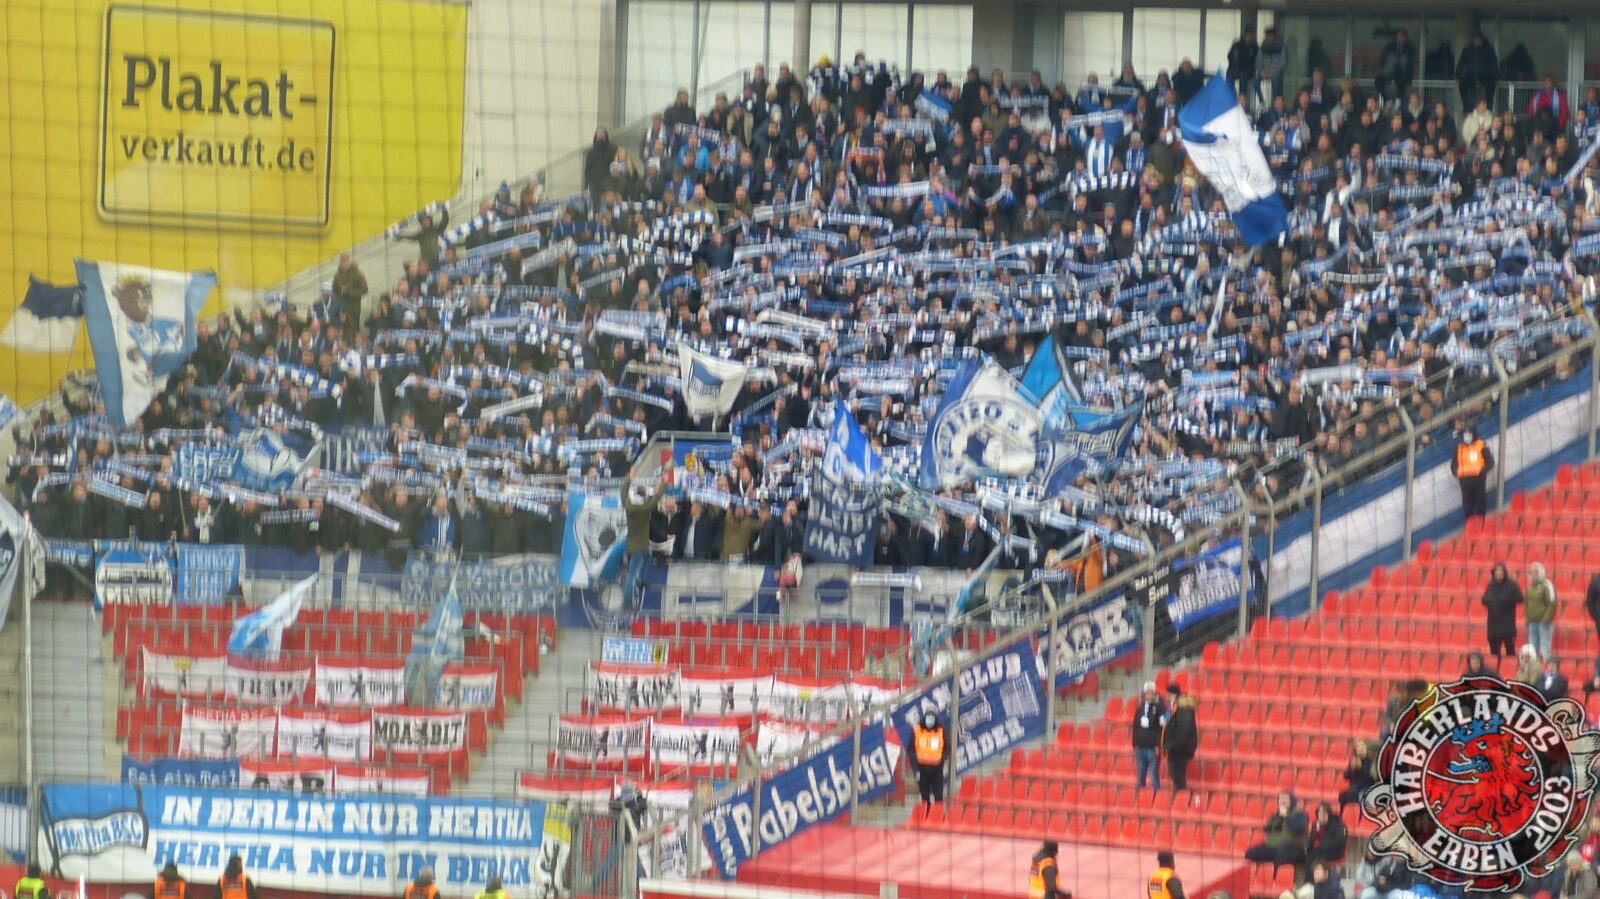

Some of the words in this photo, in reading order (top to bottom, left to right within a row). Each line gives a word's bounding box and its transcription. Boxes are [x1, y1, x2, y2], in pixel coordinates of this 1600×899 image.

[121, 54, 317, 119] Plakat-
[121, 129, 315, 172] verkauft.de
[956, 716, 1025, 776] ERDER
[161, 795, 202, 827] IN
[207, 797, 336, 833] BERLIN
[342, 802, 418, 836] NUR
[429, 805, 532, 841] HERTHA
[153, 839, 297, 873] HERTHA
[307, 848, 387, 881] NUR
[397, 853, 437, 885] IN
